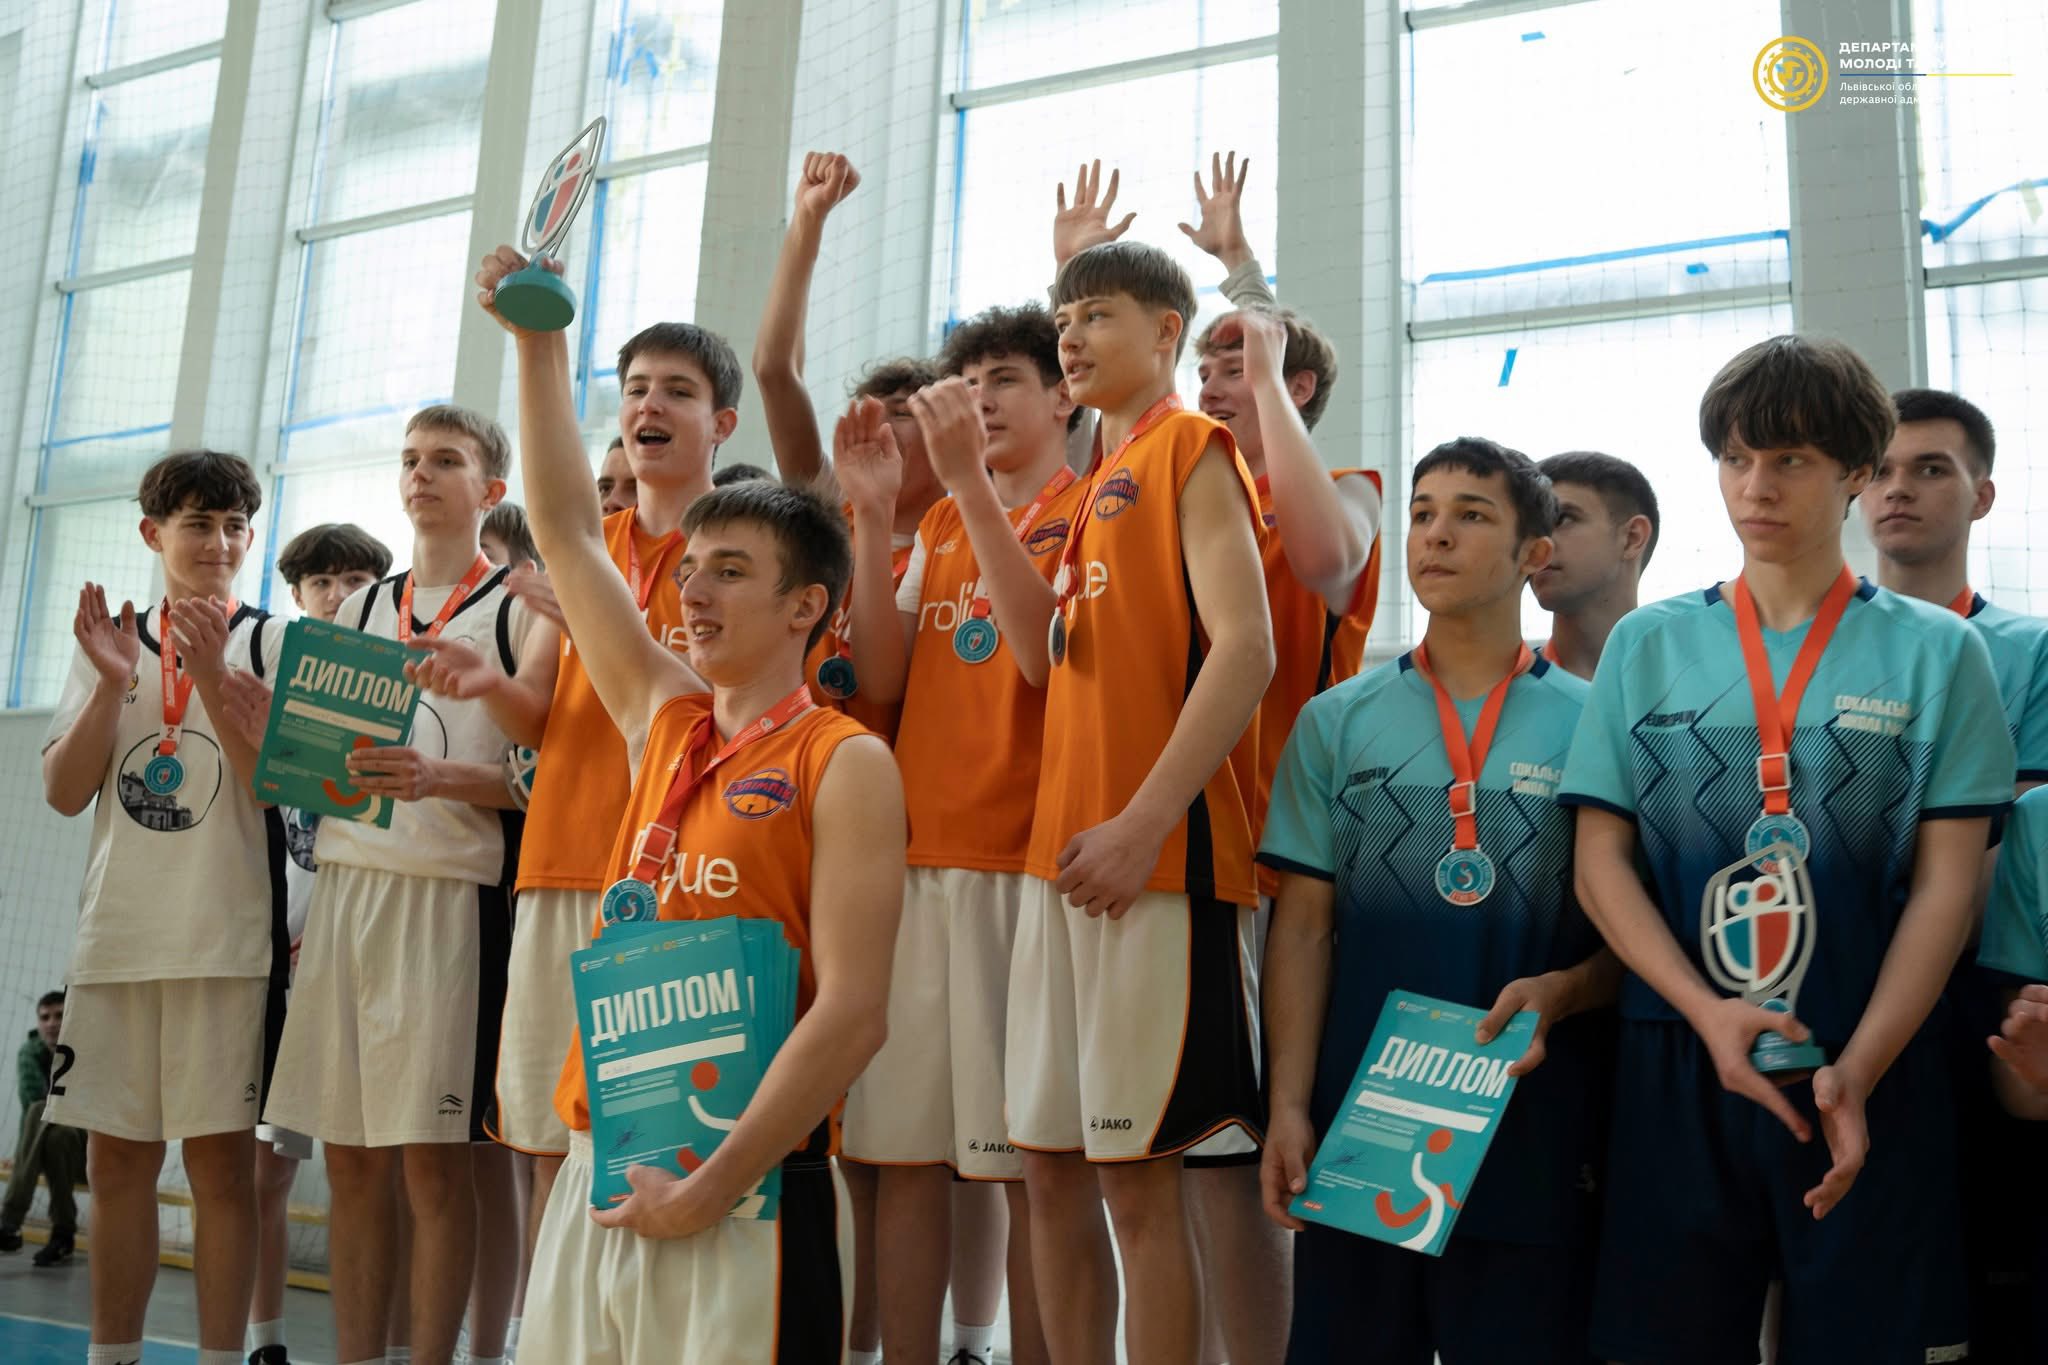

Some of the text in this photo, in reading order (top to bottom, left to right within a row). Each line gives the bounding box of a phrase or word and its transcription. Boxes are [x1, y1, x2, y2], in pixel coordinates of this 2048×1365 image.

[289, 654, 416, 714] ДИПЛОМ
[165, 726, 176, 739] 2
[591, 968, 741, 1047] ДИПЛОМ
[1368, 1035, 1515, 1098] ДИПЛОМ
[1100, 1118, 1132, 1130] JAKO
